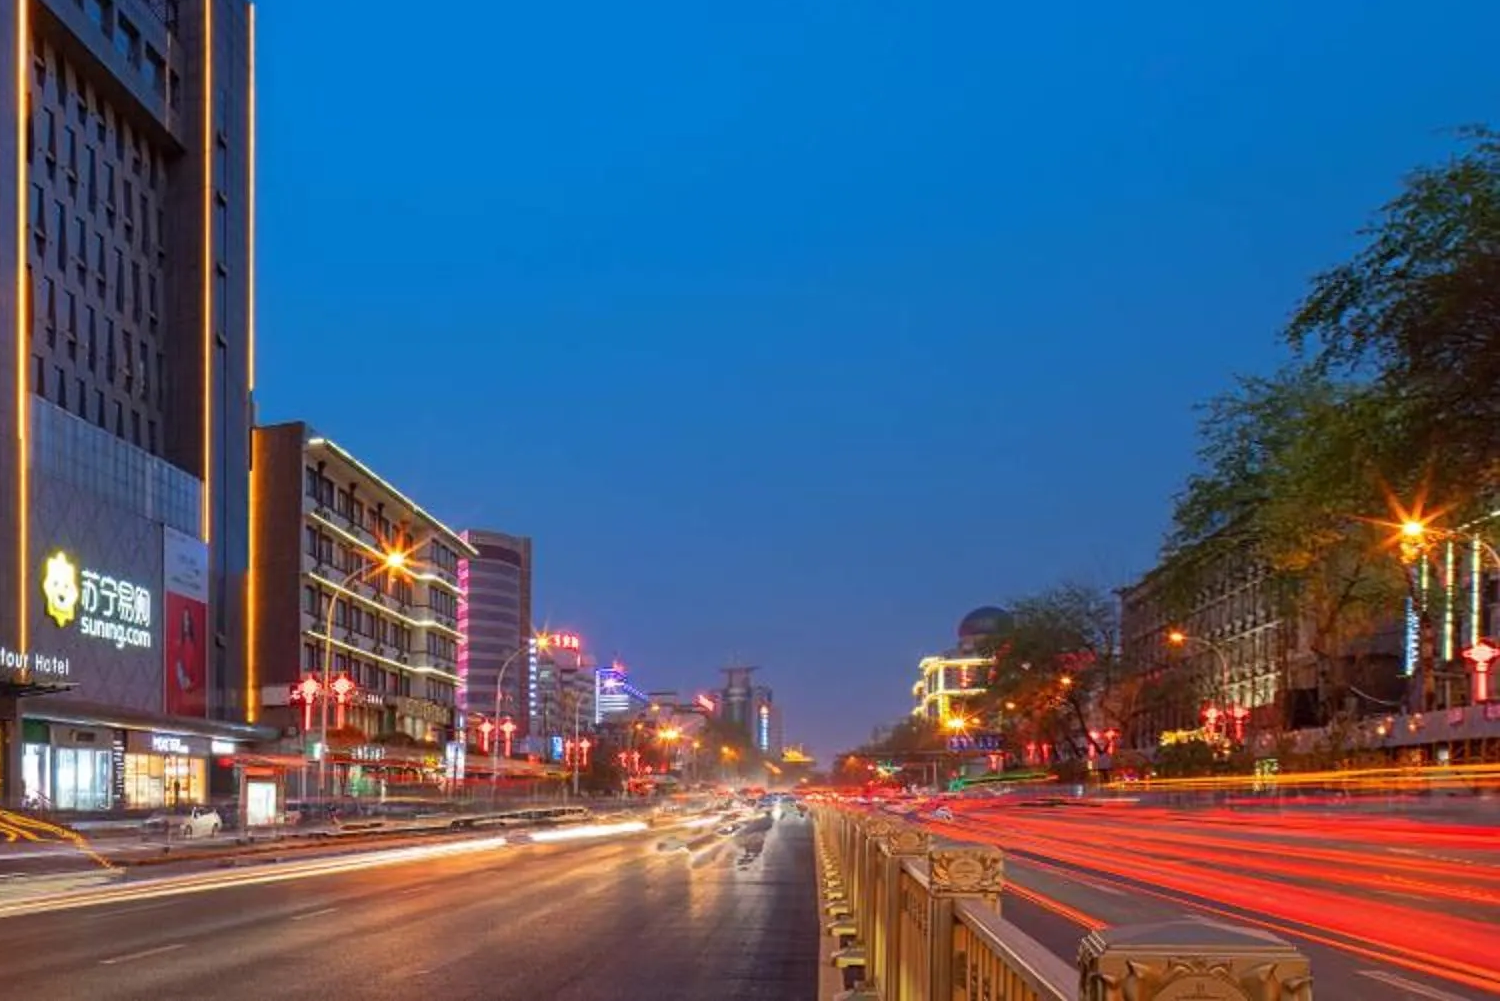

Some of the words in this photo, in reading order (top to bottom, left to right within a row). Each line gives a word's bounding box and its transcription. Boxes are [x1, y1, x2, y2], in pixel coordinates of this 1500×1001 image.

[81, 568, 151, 628] 苏宁易购
[80, 615, 151, 650] suning.com
[35, 653, 70, 676] Hotel
